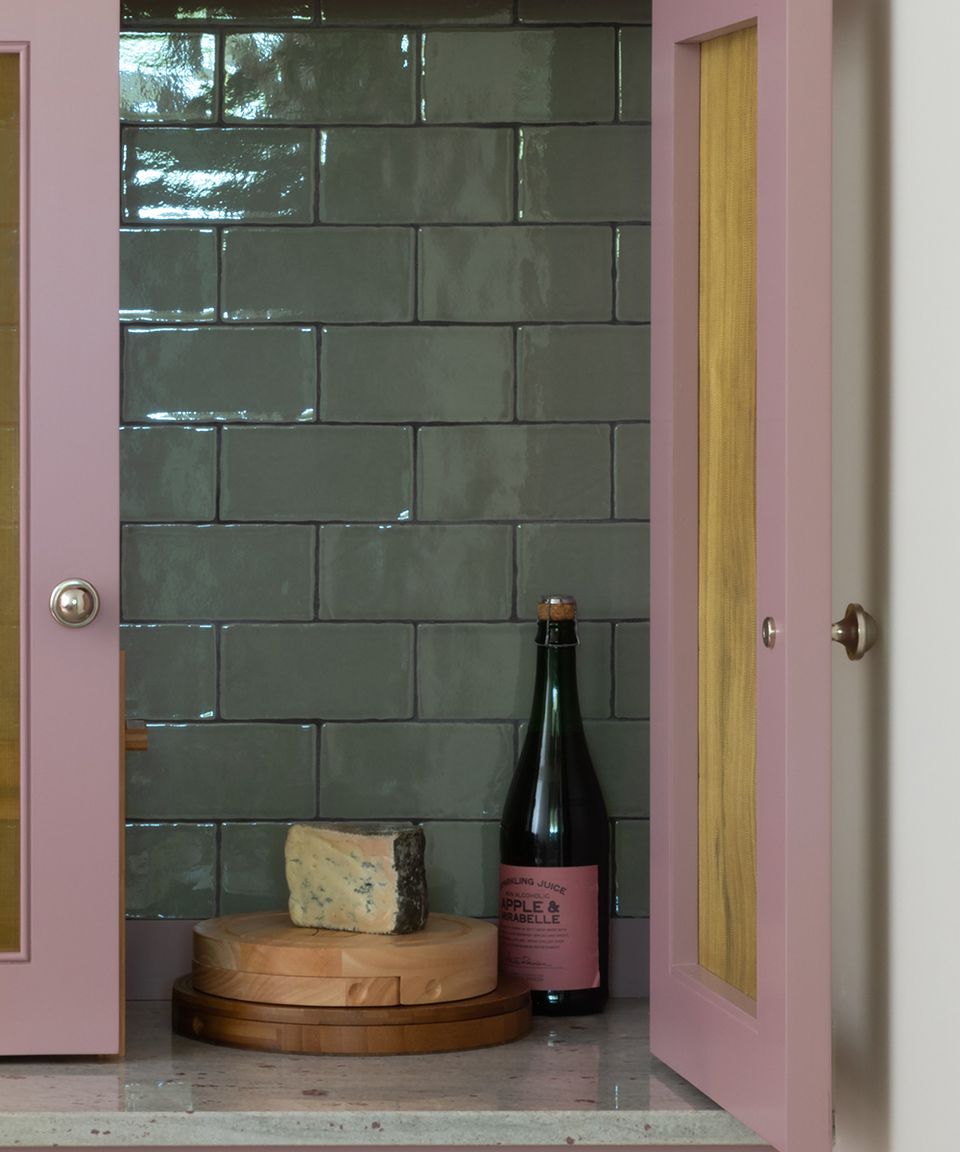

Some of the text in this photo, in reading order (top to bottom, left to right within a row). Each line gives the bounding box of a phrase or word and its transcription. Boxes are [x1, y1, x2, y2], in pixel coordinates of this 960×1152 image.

[537, 879, 567, 895] JUICE
[501, 898, 560, 913] APPLE &
